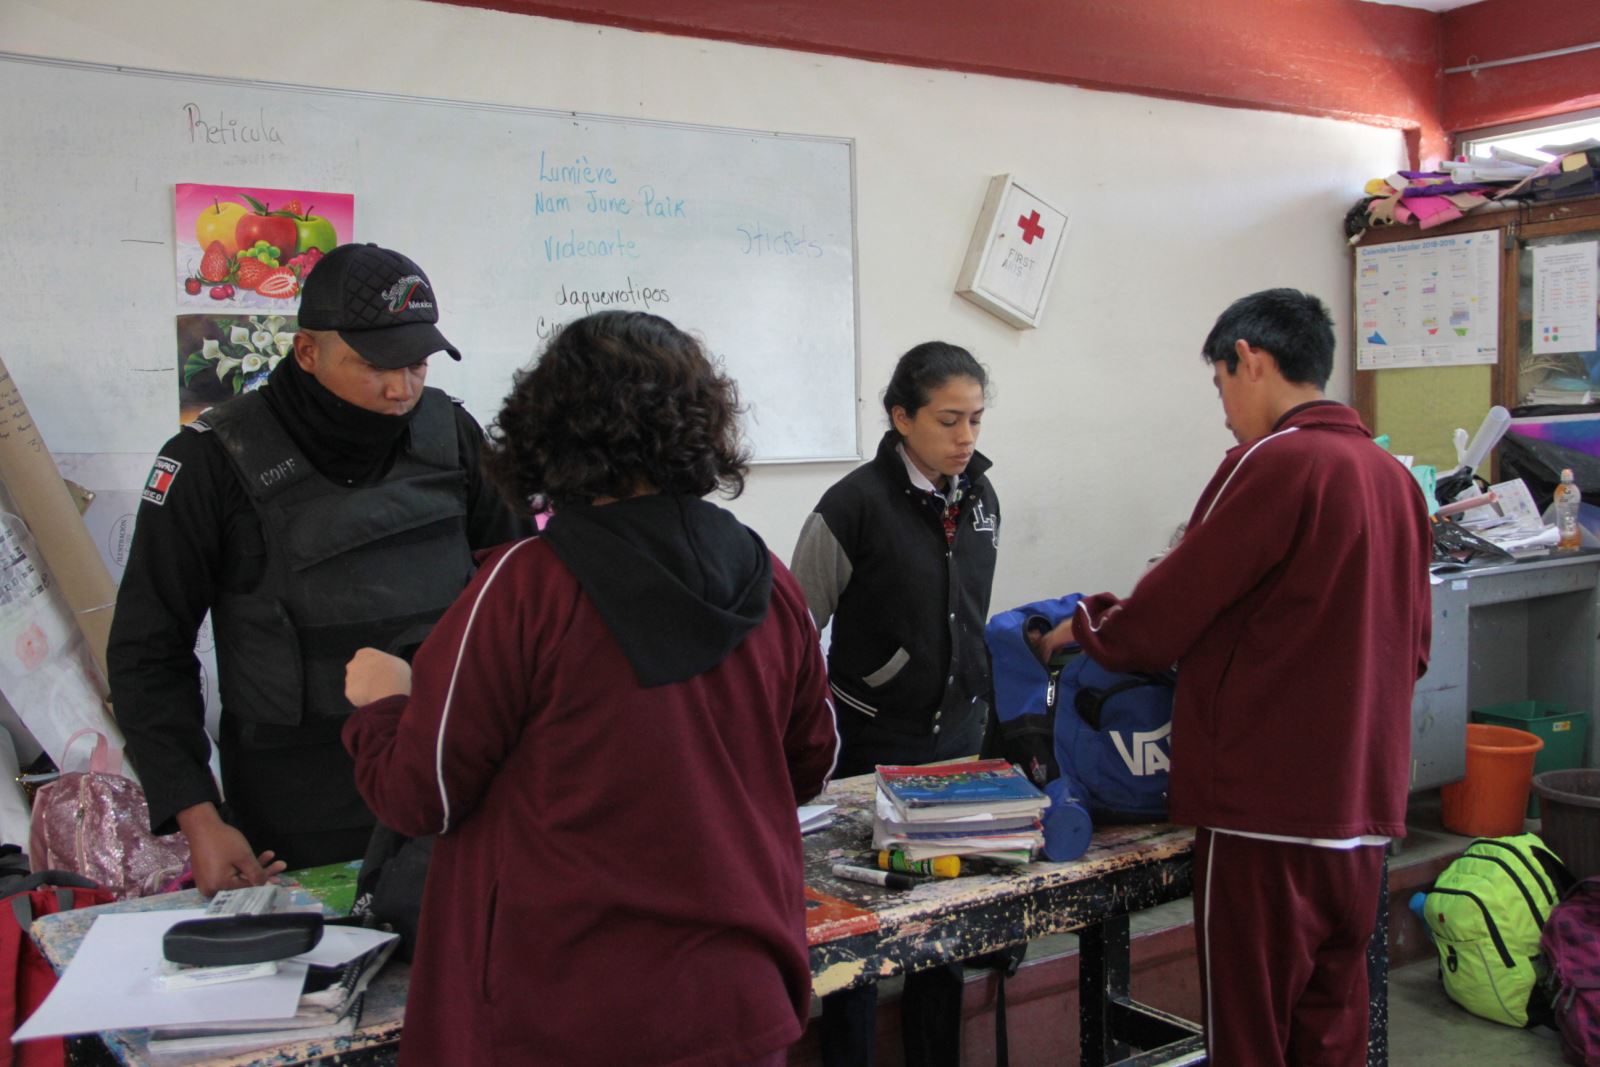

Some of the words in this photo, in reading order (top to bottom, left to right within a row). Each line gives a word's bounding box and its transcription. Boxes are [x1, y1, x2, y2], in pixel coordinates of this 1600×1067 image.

[540, 151, 617, 184] Lumière
[535, 191, 571, 216] Nam
[585, 190, 632, 215] June
[1397, 243, 1420, 253] Escolar
[1109, 720, 1172, 776] VA
